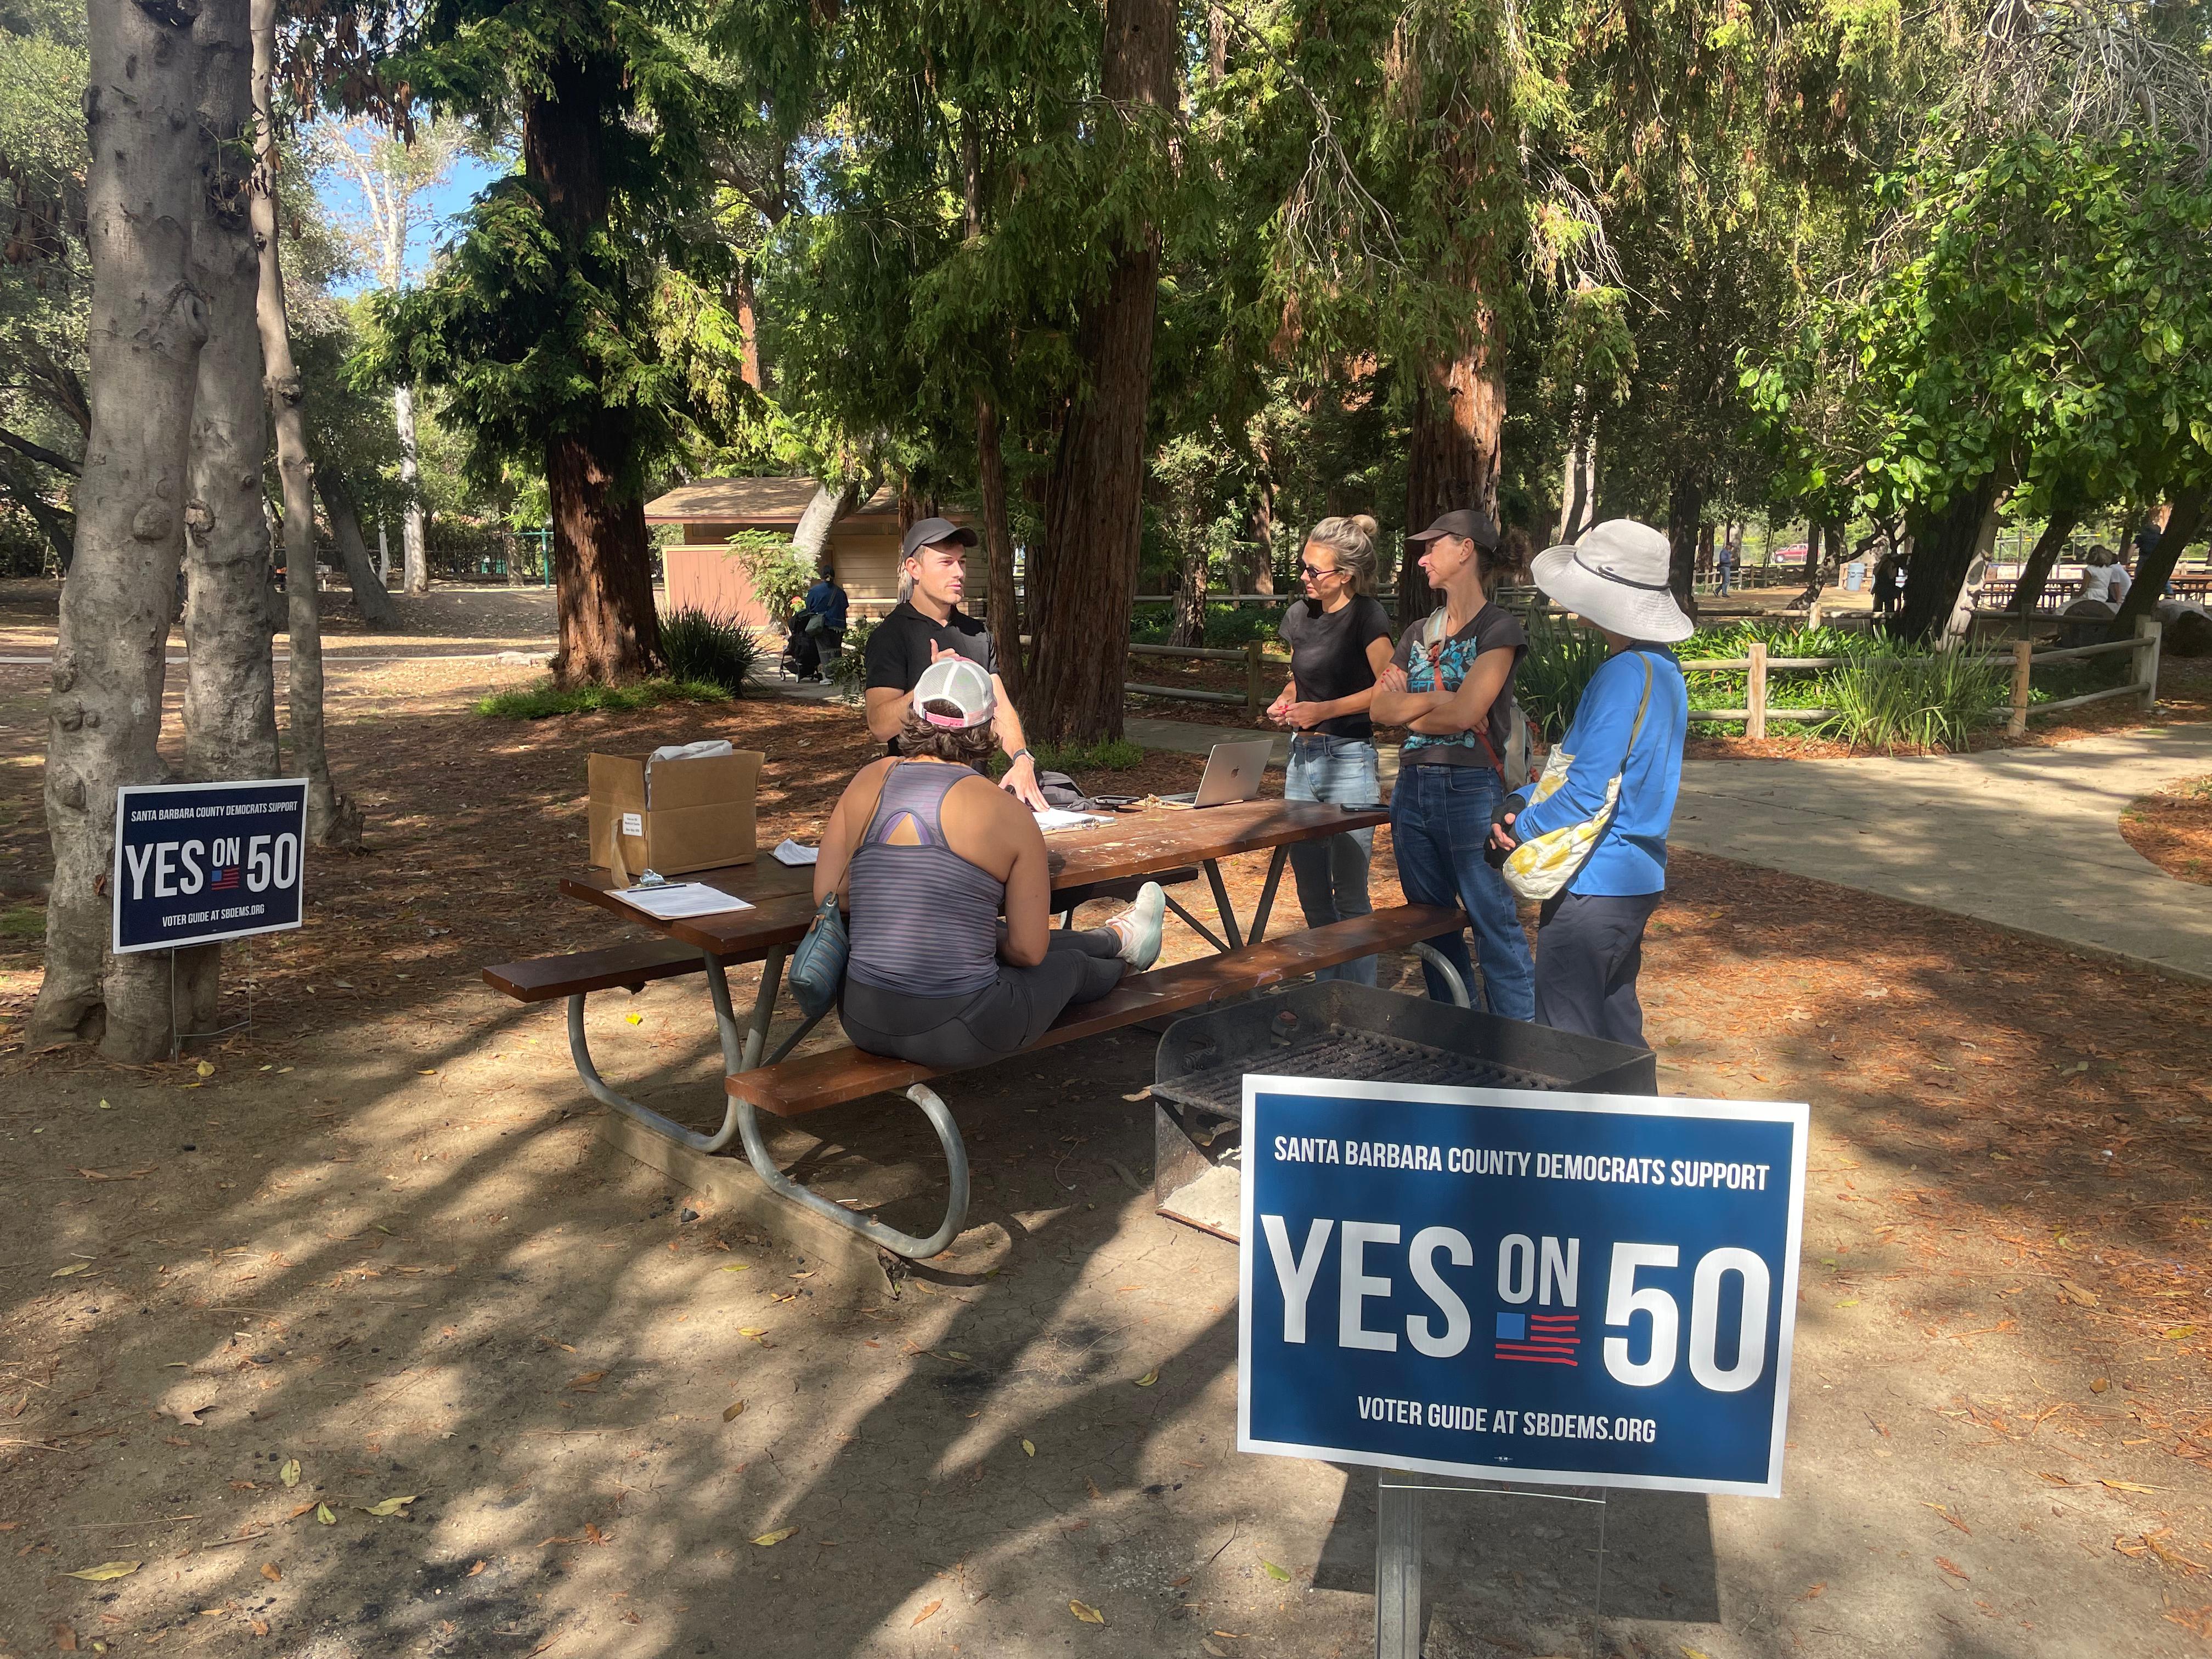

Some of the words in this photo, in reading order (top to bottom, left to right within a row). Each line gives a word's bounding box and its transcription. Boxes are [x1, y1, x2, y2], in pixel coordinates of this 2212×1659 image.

[131, 809, 157, 822] SANTA
[159, 807, 194, 820] BARBARA
[196, 806, 225, 818] COUNTY
[225, 803, 267, 816] DEMOCRATS
[268, 801, 298, 812] SUPPORT
[125, 839, 205, 900] YES
[212, 837, 240, 867] ON
[247, 832, 297, 892] 50
[162, 914, 187, 927] VOTER
[188, 911, 210, 924] GUIDE
[210, 909, 220, 921] AT
[221, 904, 264, 919] SBDEMS.ORG
[1274, 1136, 1340, 1164] SANTA
[1345, 1141, 1442, 1172] BARBARA
[1448, 1147, 1531, 1177] COUNTY
[1536, 1153, 1666, 1186] DEMOCRATS
[1670, 1159, 1770, 1190] SUPPORT
[1260, 1214, 1474, 1358] YES
[1498, 1233, 1579, 1307] ON
[1603, 1242, 1770, 1392] 50
[1358, 1396, 1422, 1425] VOTER
[1427, 1403, 1488, 1432] GUIDE
[1492, 1409, 1519, 1434] AT
[1523, 1412, 1656, 1443] SBDEMS.ORG
